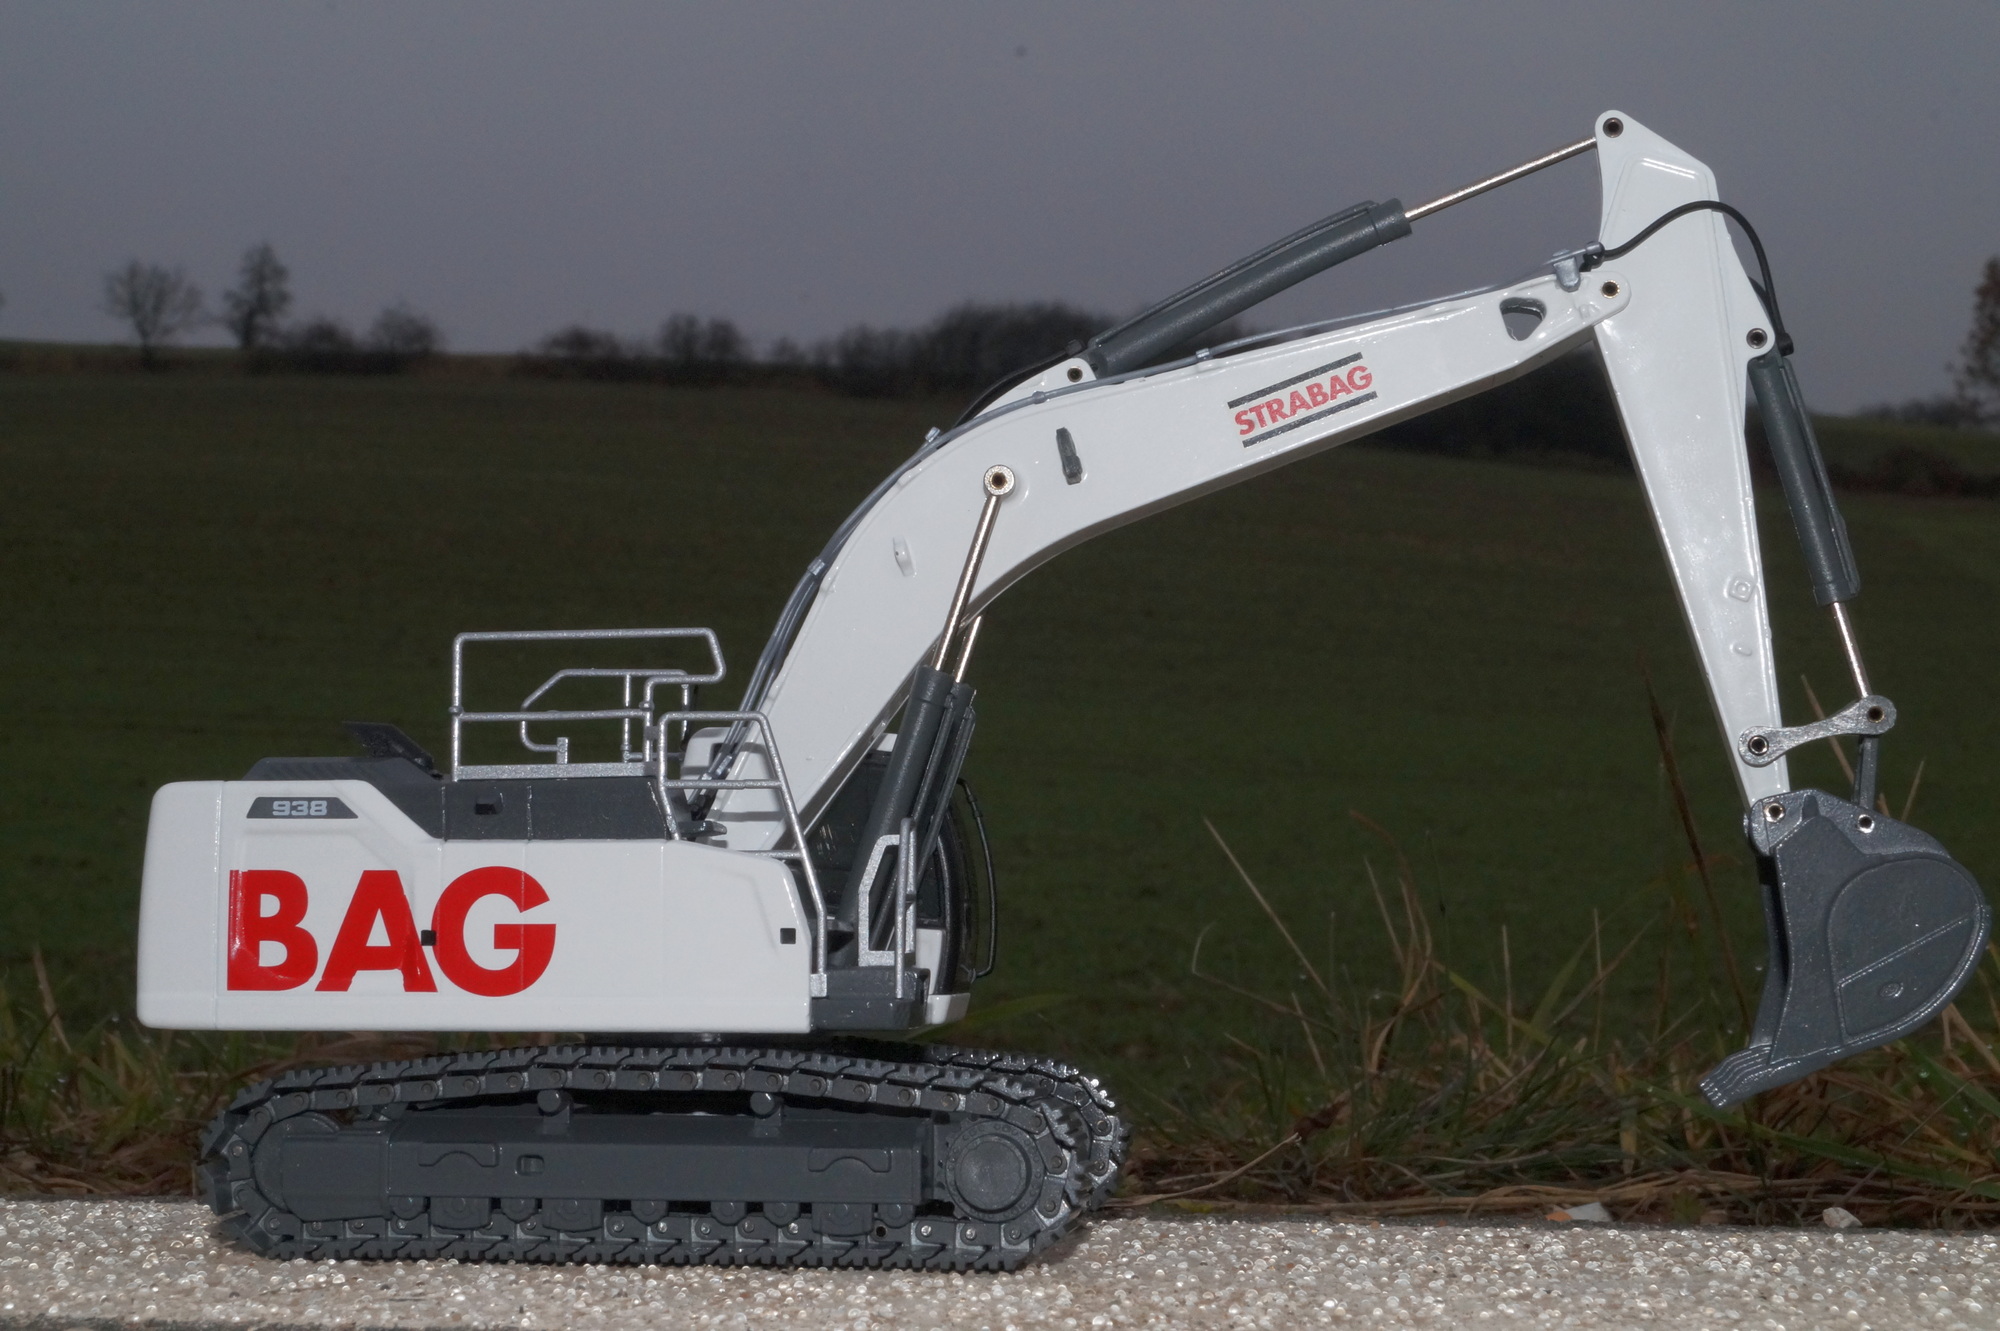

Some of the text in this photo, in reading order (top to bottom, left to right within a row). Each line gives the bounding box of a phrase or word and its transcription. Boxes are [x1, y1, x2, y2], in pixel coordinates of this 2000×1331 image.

[1234, 365, 1373, 435] STRABAG
[272, 800, 328, 816] 938
[227, 866, 557, 997] BAG
